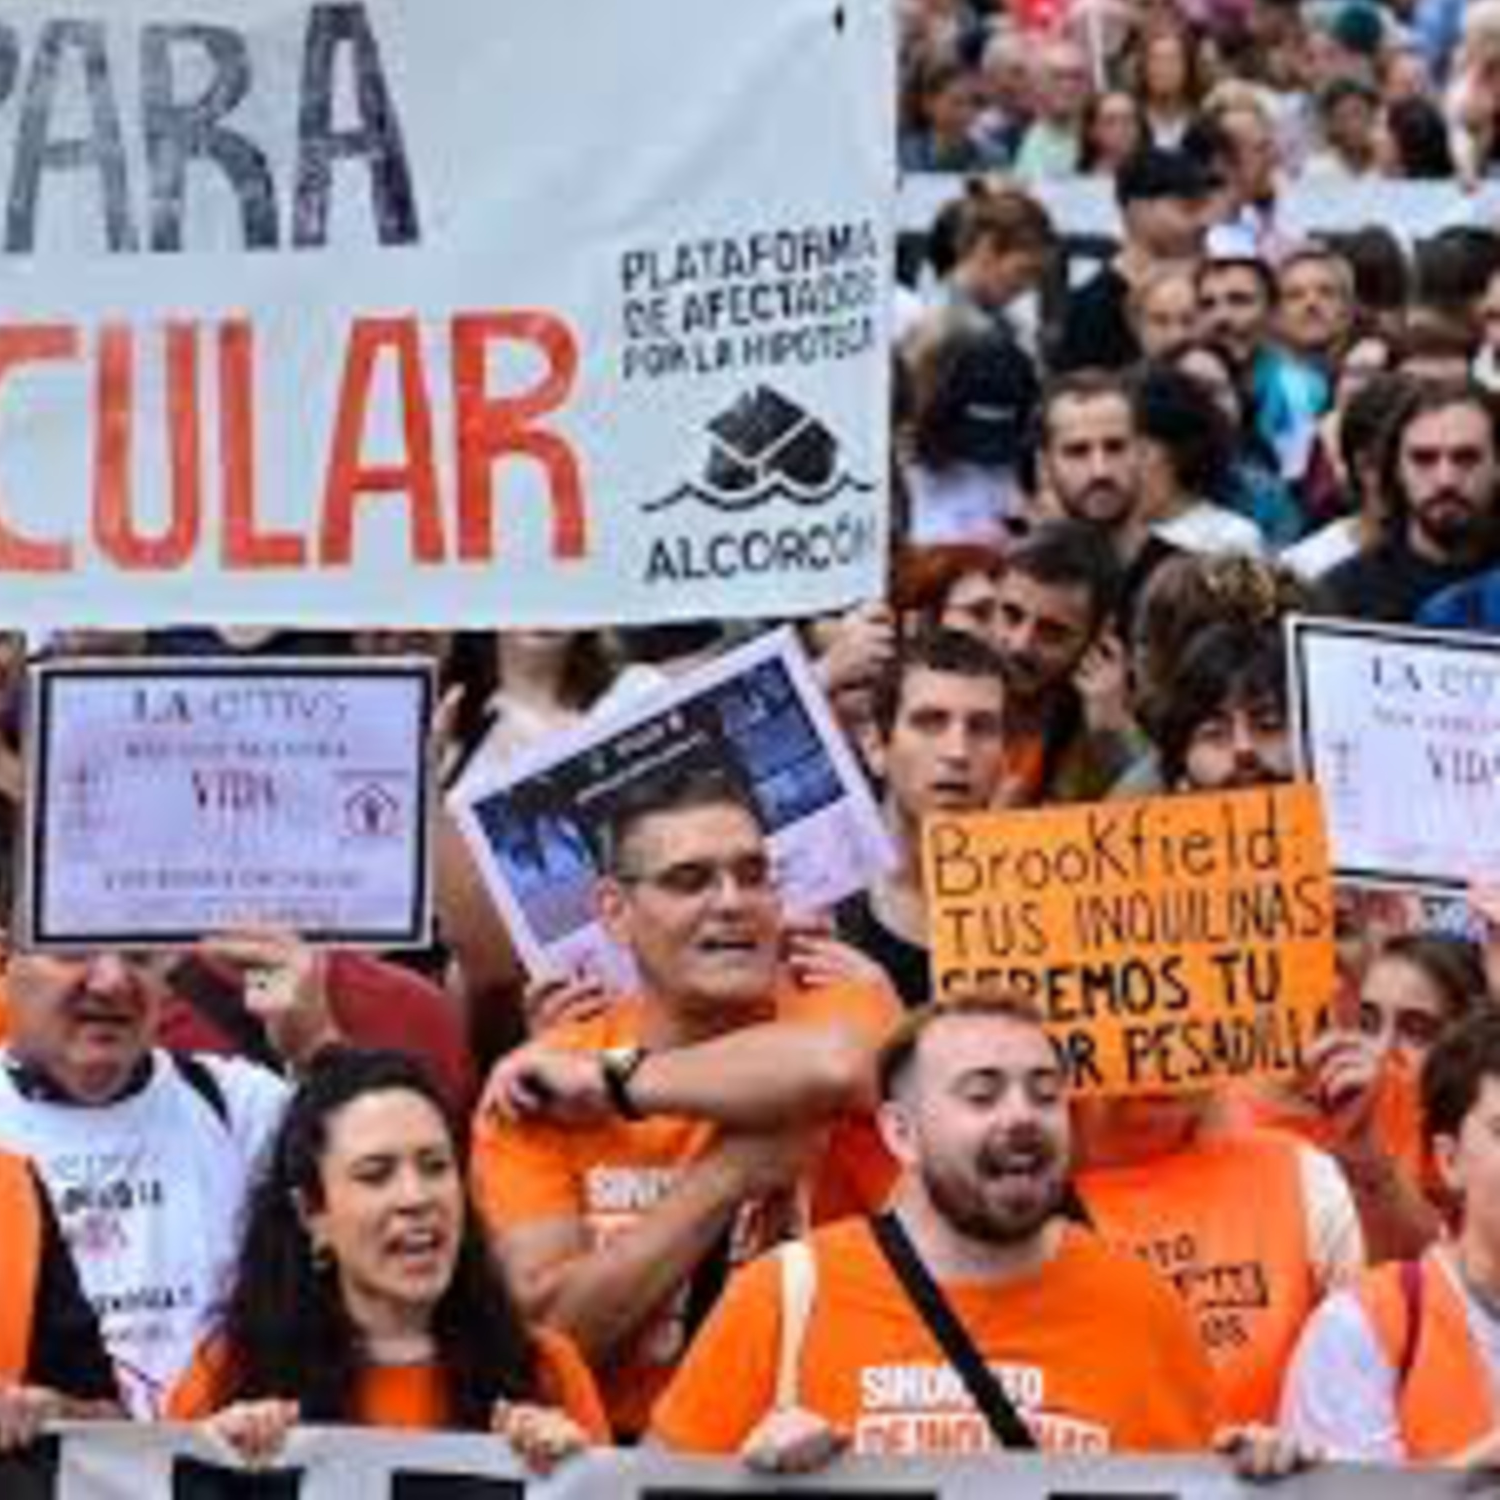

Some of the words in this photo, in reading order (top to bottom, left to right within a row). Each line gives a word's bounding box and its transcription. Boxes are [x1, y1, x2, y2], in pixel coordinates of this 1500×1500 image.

[620, 220, 877, 293] PLATAFORMA
[942, 900, 1048, 960] TUS
[1210, 947, 1281, 1008] TU
